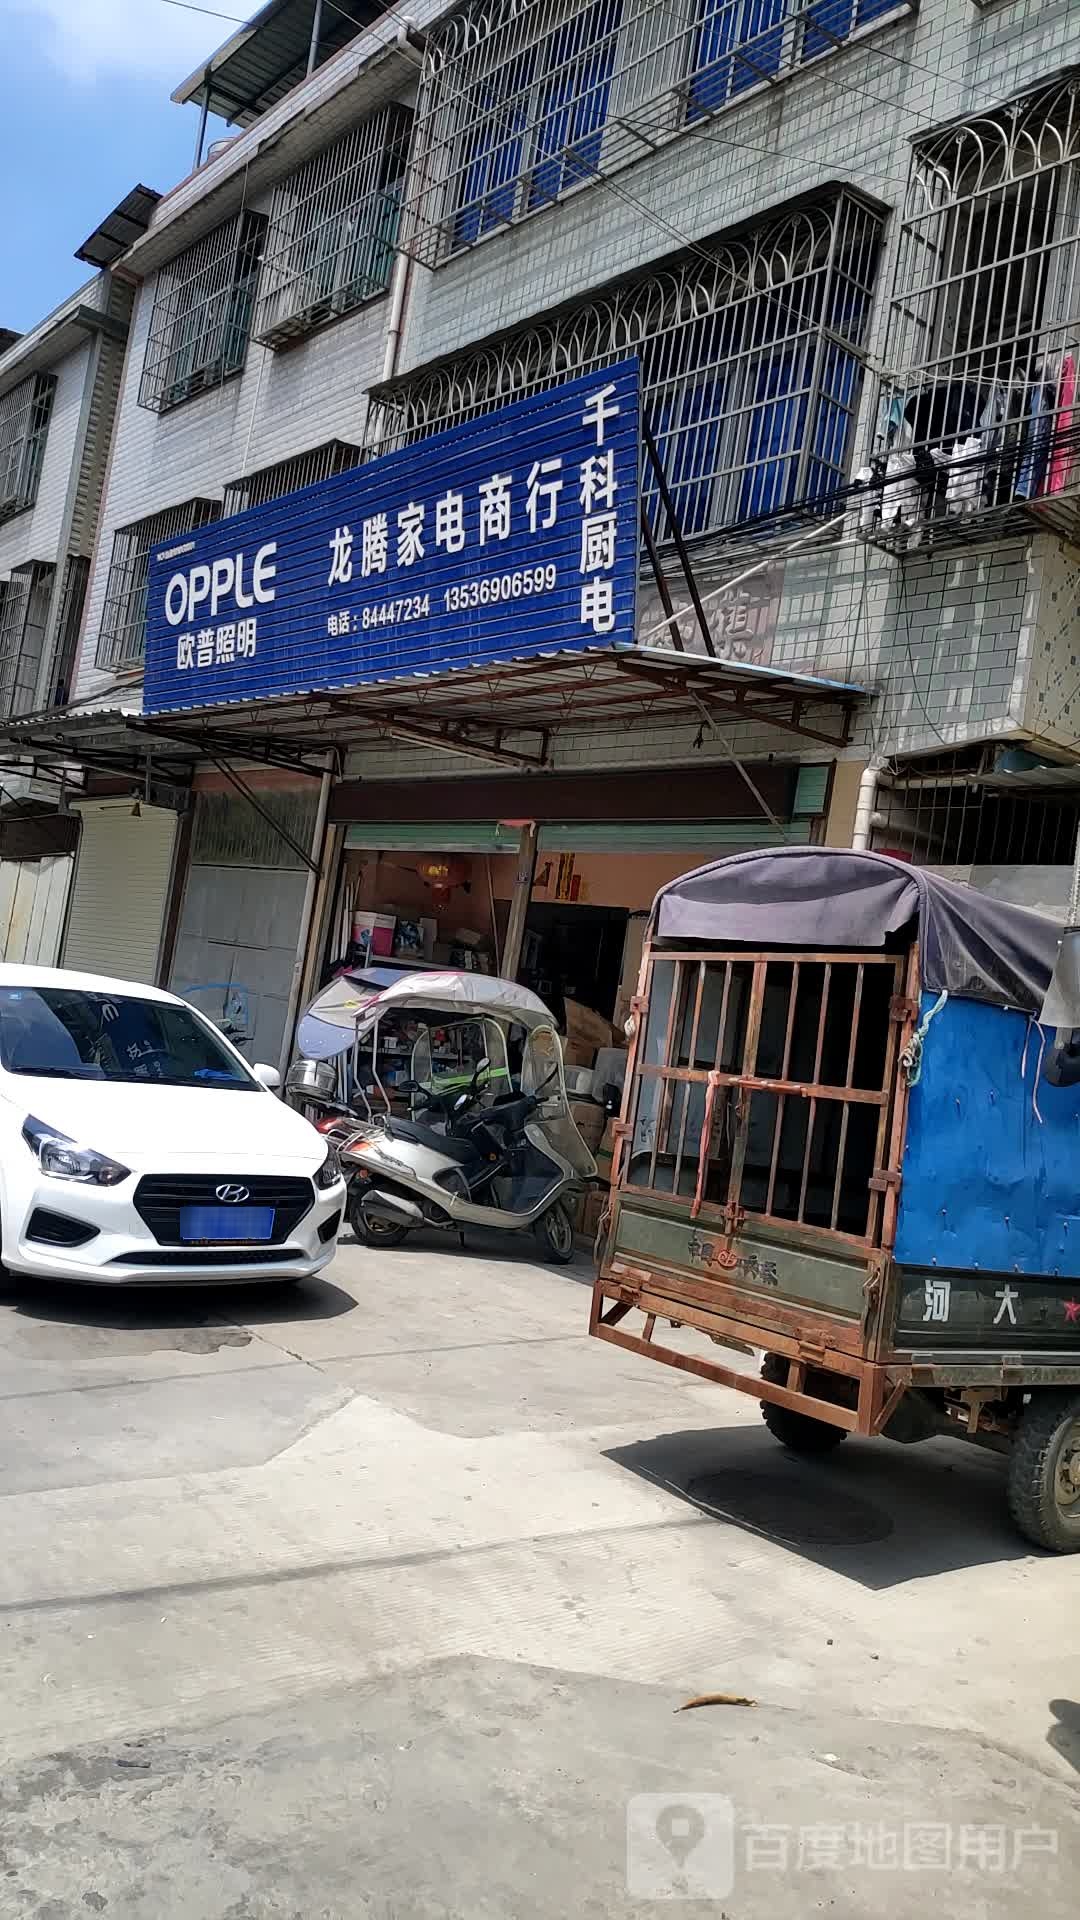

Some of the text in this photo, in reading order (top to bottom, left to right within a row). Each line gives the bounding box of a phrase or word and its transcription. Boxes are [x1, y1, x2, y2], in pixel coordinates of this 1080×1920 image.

[327, 458, 564, 587] 龙腾家电商行
[579, 384, 620, 633] 千科厨电
[165, 542, 277, 625] OPPLE
[444, 564, 557, 612] 13536906599
[176, 617, 258, 670] 欧普照明
